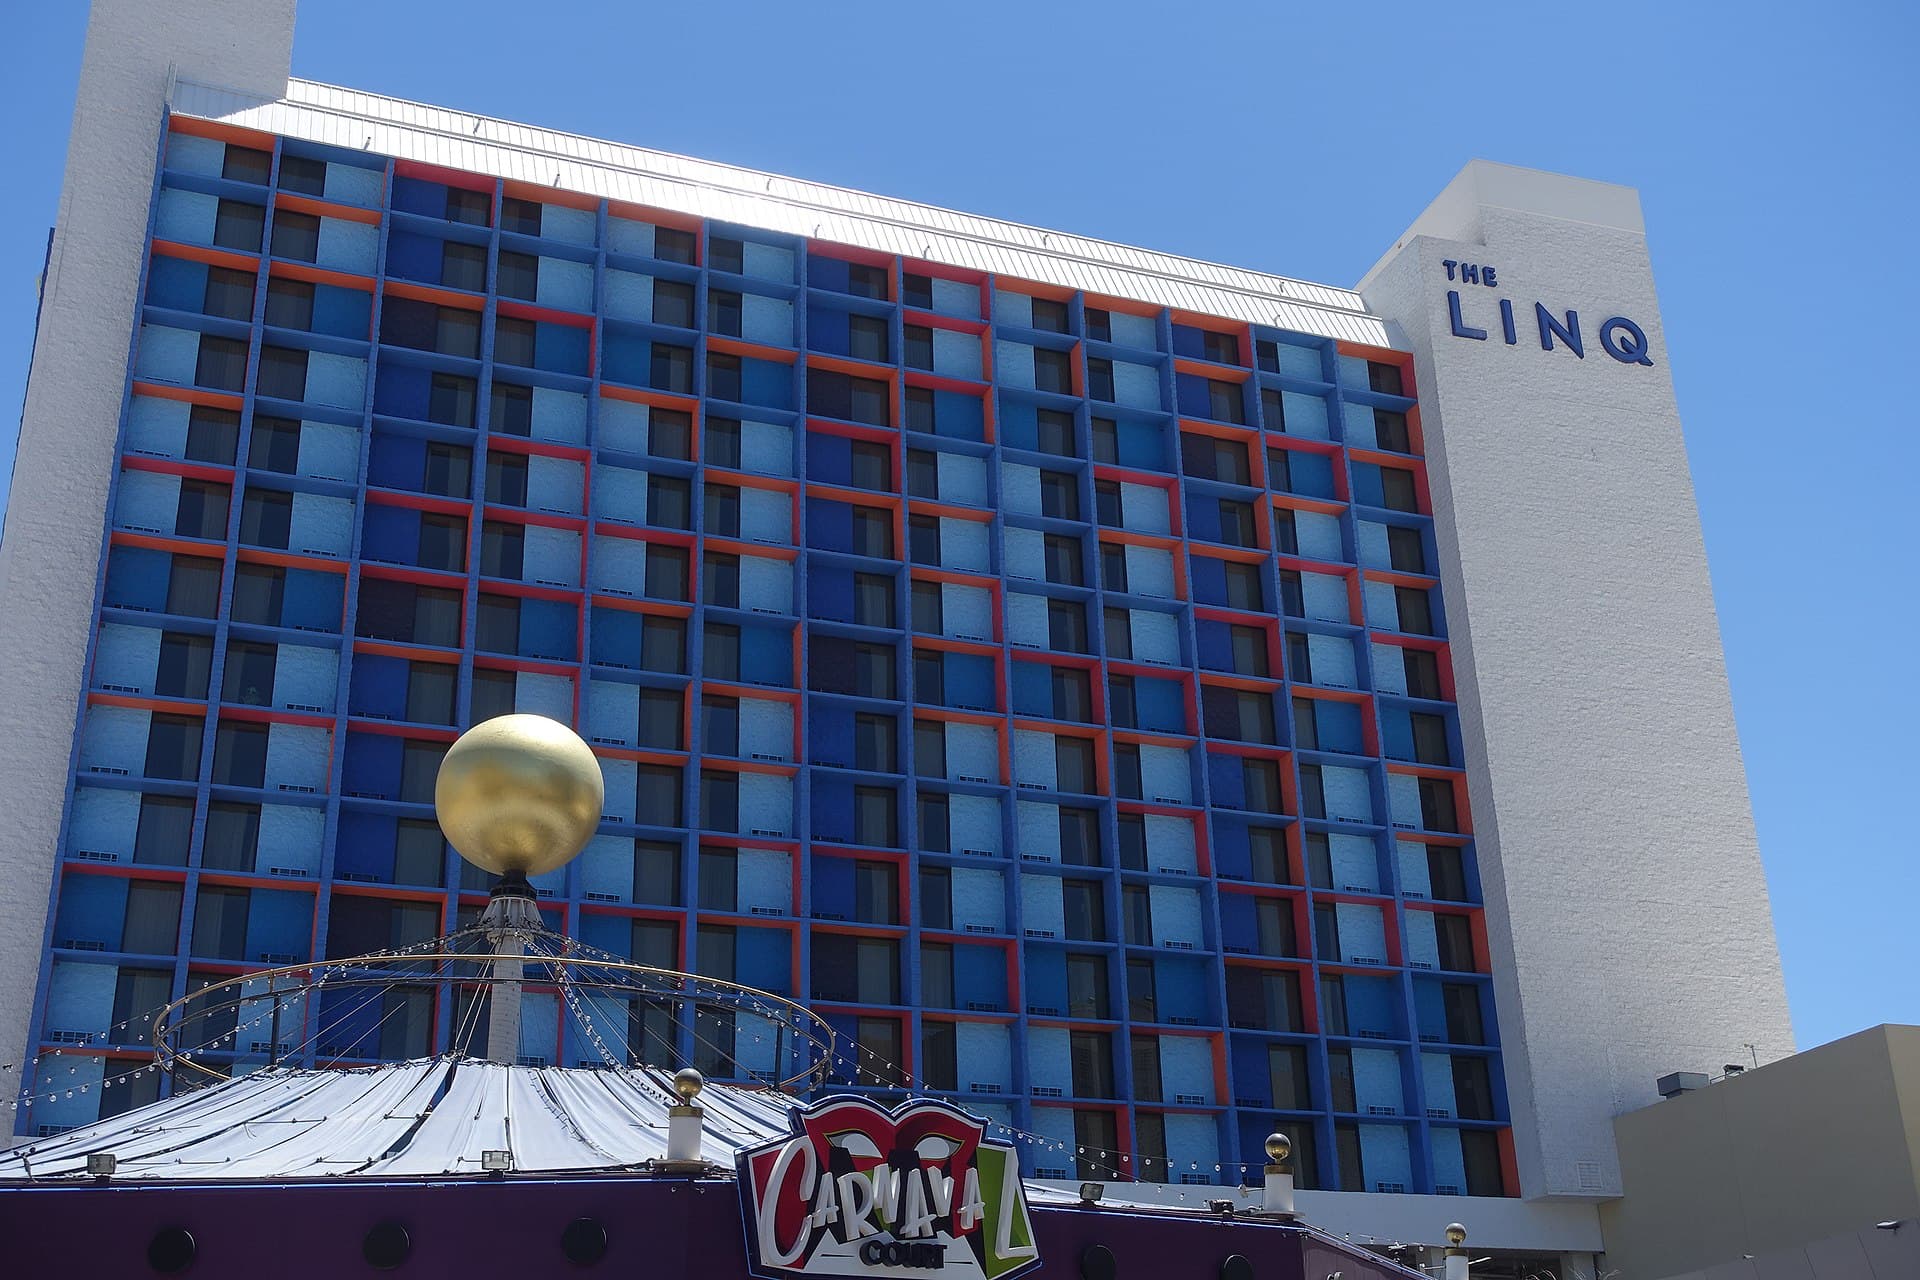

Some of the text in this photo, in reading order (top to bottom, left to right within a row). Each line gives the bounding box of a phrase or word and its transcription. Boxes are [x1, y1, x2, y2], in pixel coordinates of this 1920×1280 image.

[1443, 259, 1498, 288] THE
[1447, 290, 1654, 367] LINQ
[761, 1136, 1037, 1265] CARNAVAL
